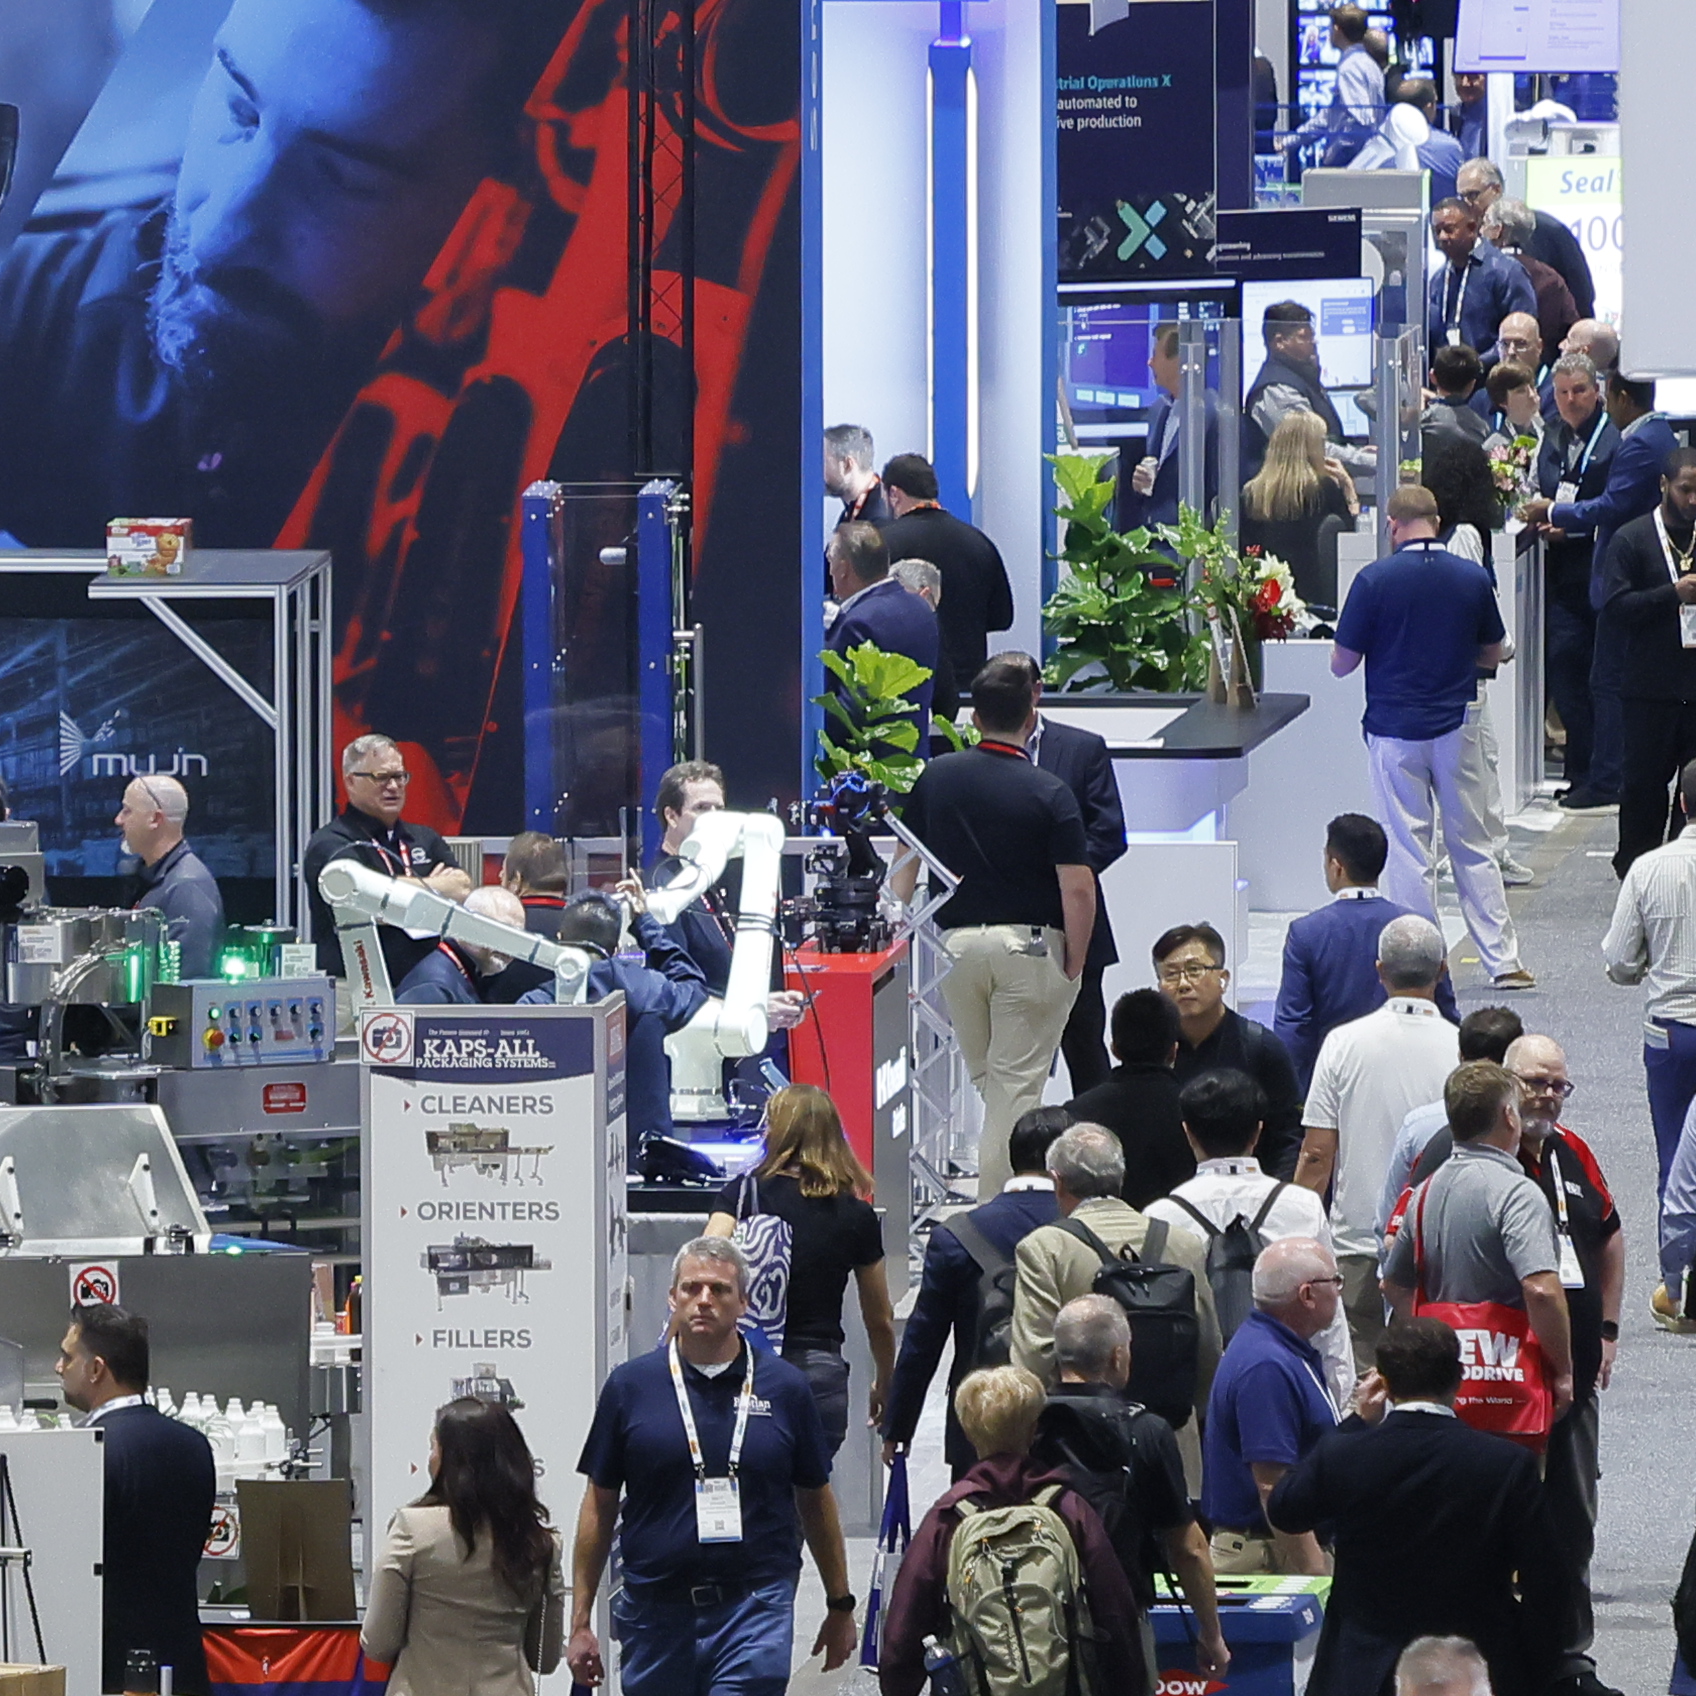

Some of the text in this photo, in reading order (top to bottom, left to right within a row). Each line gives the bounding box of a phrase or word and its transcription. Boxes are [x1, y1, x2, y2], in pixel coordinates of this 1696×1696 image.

[1056, 74, 1172, 92] trial Operations X
[1057, 94, 1138, 110] automated to
[1077, 114, 1142, 132] production
[1560, 169, 1615, 194] Seal
[92, 746, 209, 776] mujin
[423, 1039, 541, 1058] KAPS-ALL
[415, 1057, 549, 1070] PACKAGING SYSTEMS
[420, 1094, 554, 1115] CLEANERS
[416, 1200, 561, 1222] ORIENTERS
[432, 1328, 533, 1350] FILLERS
